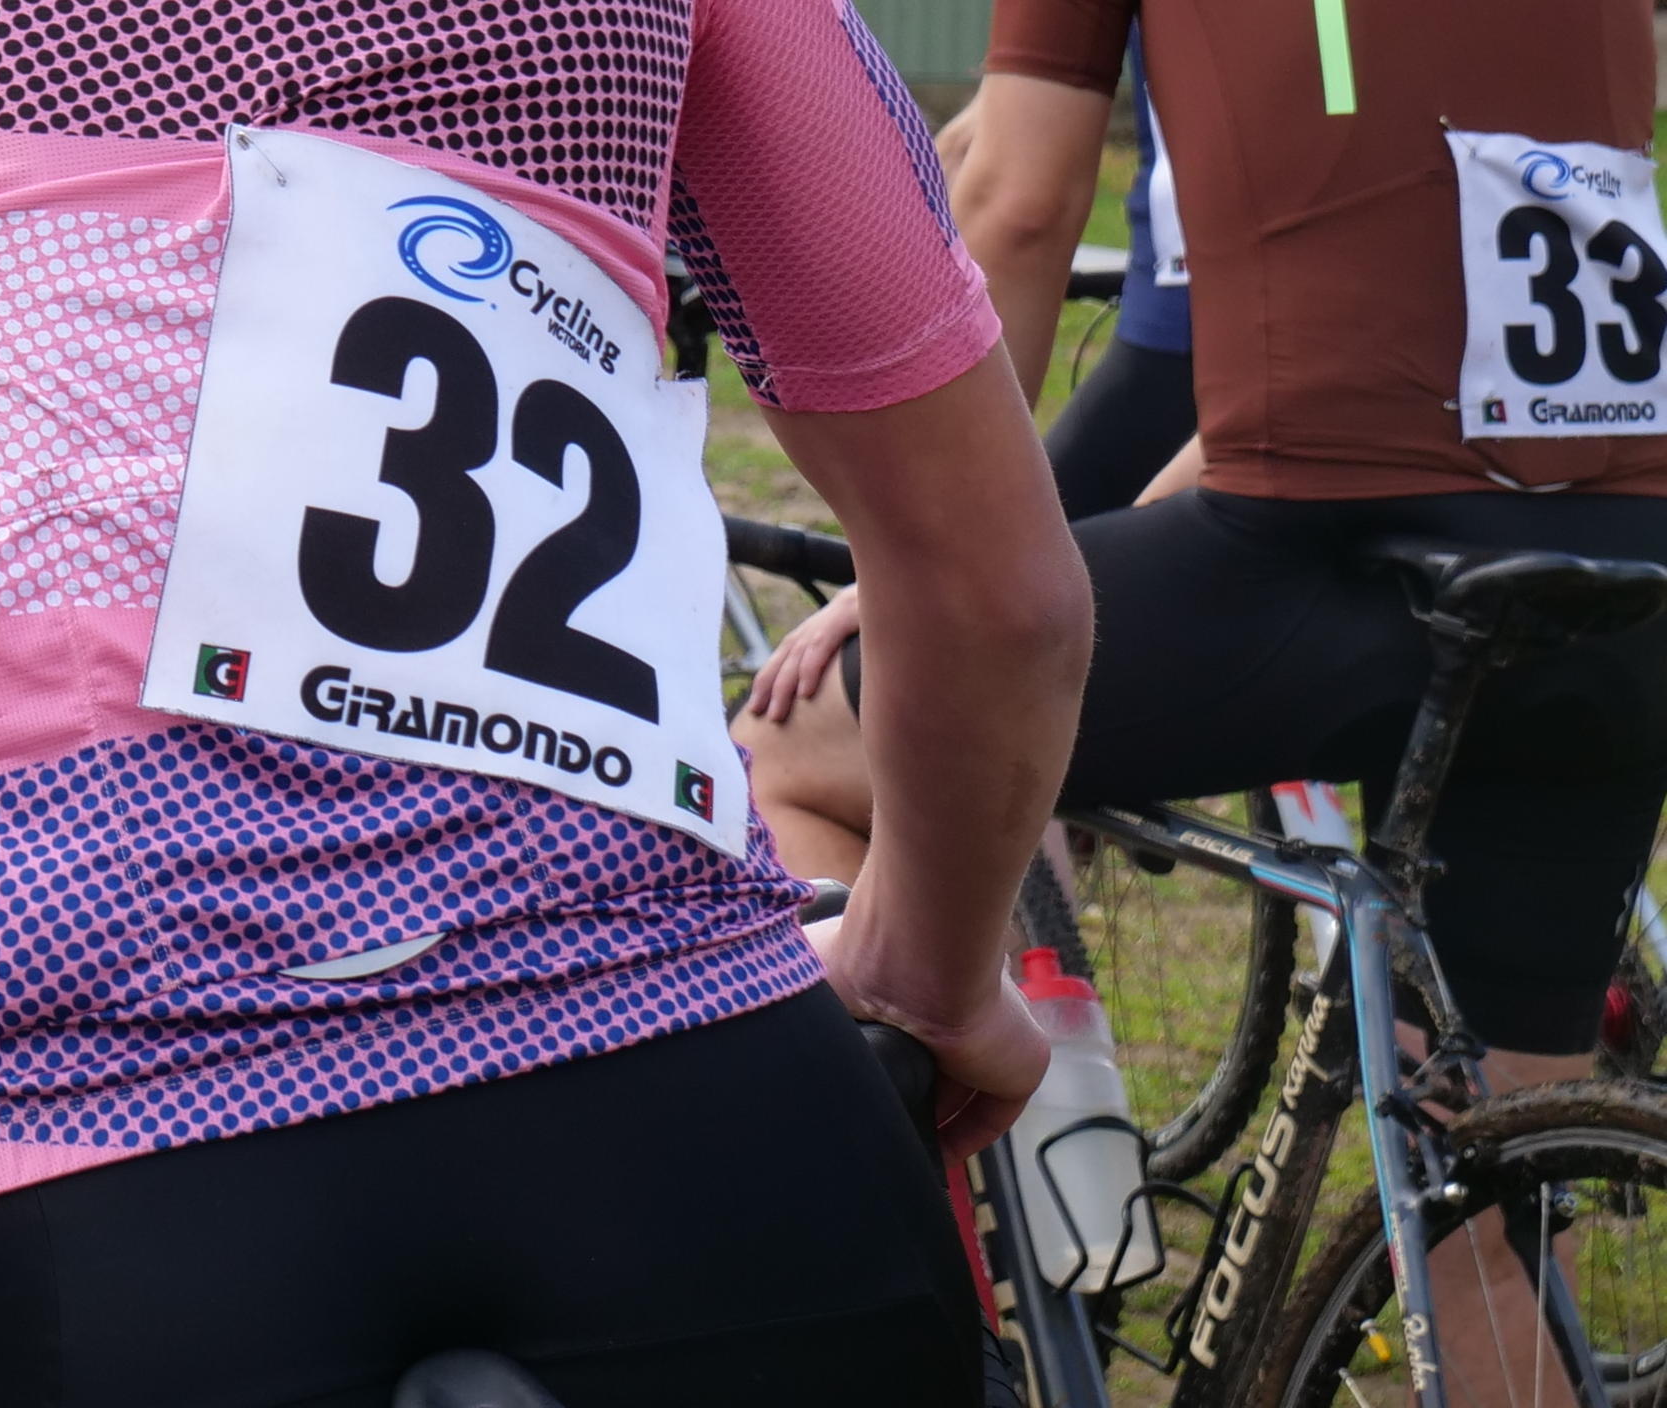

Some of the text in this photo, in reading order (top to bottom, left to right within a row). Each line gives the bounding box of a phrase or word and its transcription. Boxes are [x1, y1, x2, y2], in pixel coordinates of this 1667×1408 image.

[509, 259, 622, 374] Cycling
[546, 318, 592, 363] VICTORIA
[1496, 205, 1667, 385] 33
[297, 295, 660, 725] 32
[1190, 1106, 1298, 1369] FOCUS
